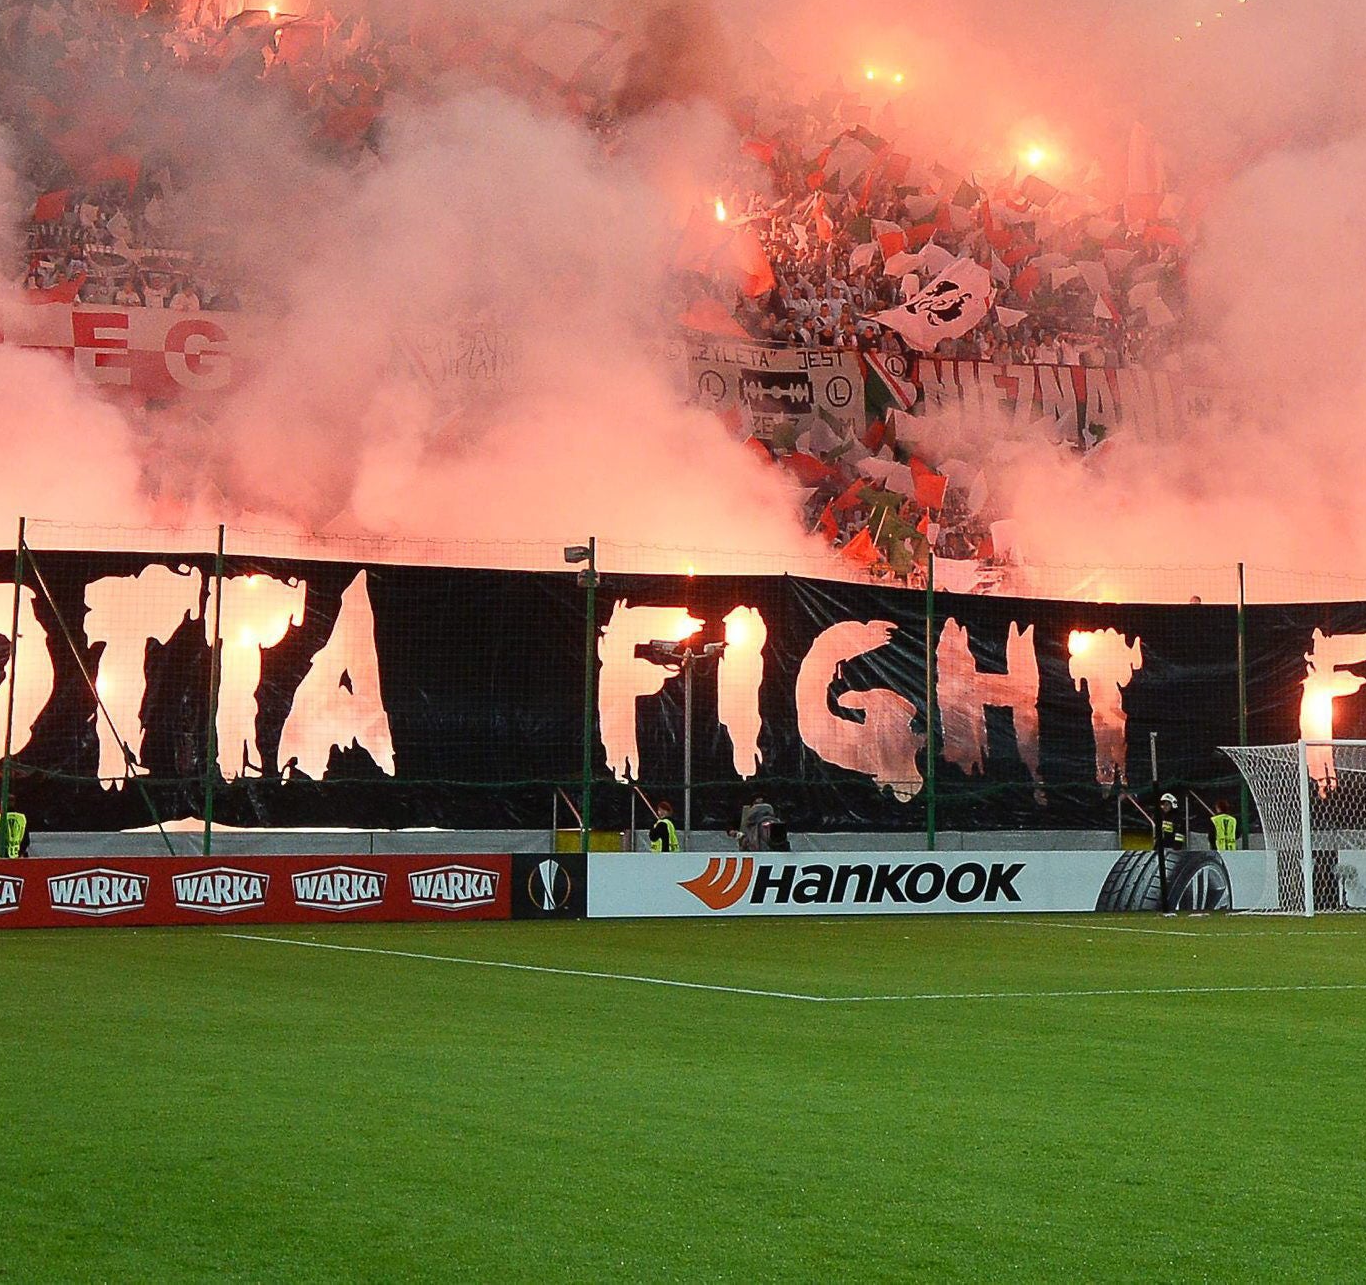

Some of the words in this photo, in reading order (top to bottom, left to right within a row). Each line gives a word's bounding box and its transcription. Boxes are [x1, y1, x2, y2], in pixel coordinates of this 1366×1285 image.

[796, 351, 844, 369] JEST
[598, 599, 1142, 805] FIGHT
[51, 877, 143, 906] WARKA
[176, 875, 263, 904] WARKA
[295, 874, 382, 903] WARKA
[412, 873, 496, 901] WARKA
